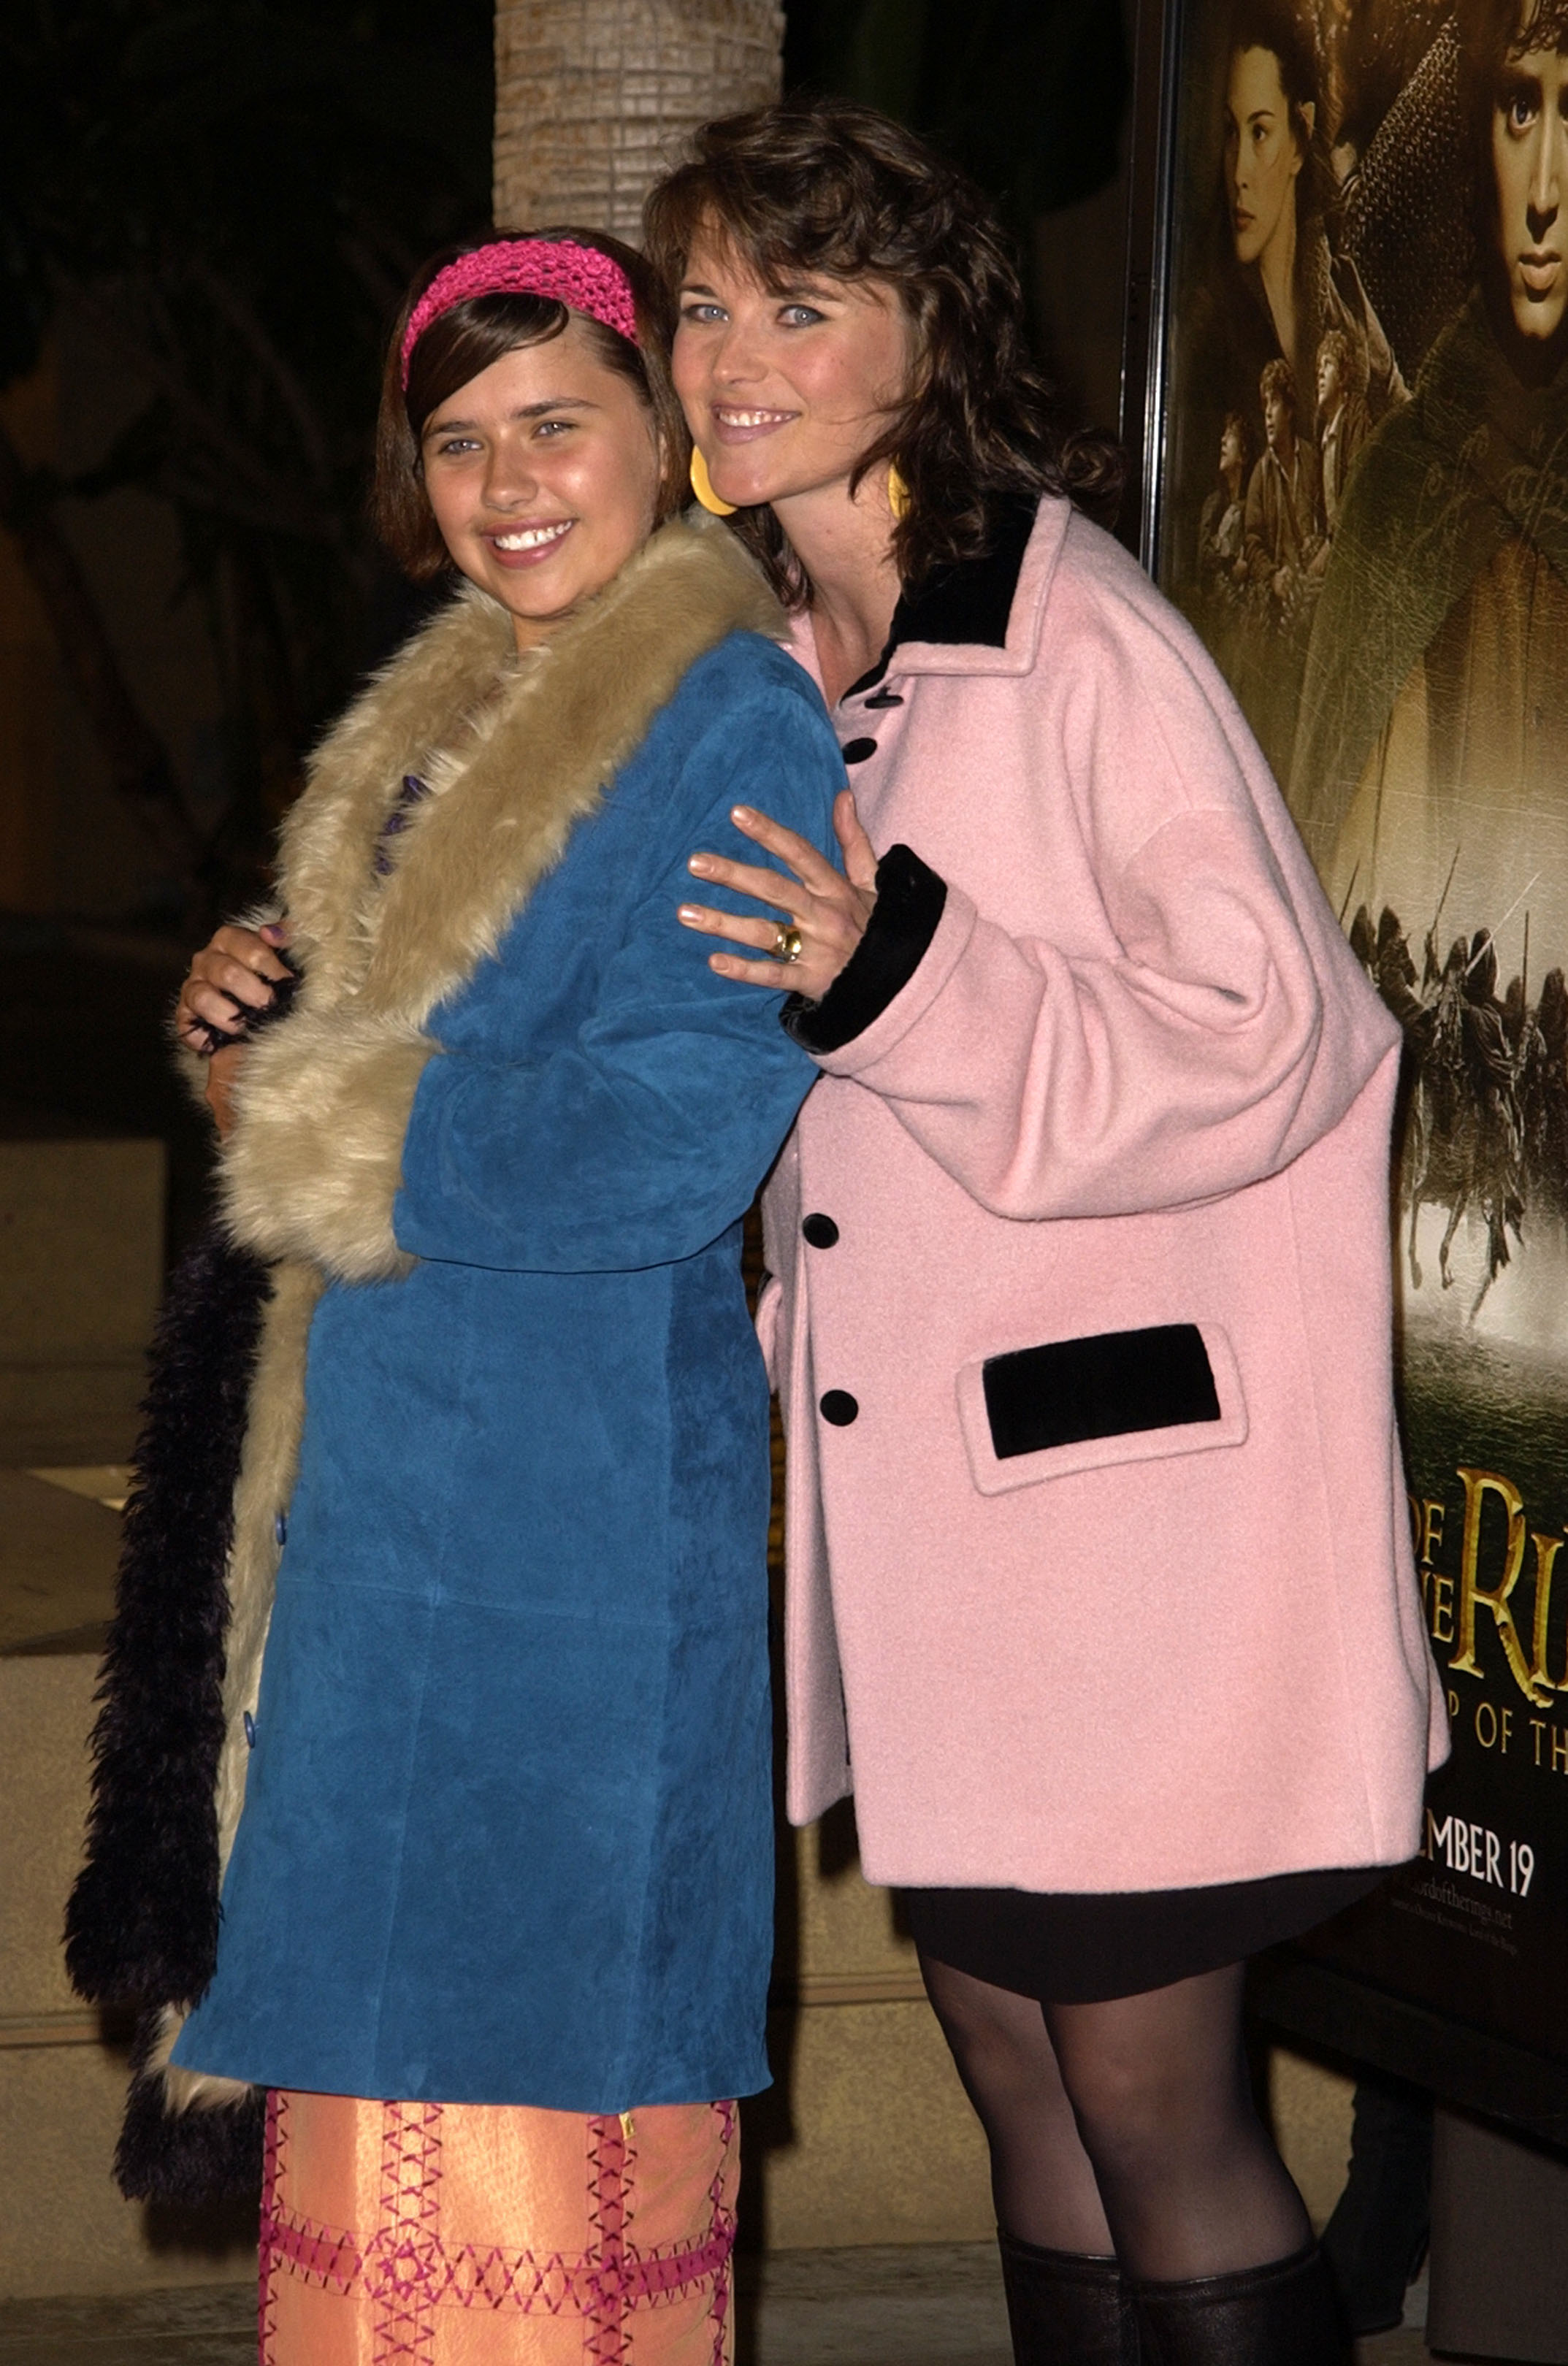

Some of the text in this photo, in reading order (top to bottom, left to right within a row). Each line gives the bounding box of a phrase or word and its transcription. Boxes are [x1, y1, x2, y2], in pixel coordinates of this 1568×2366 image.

[1475, 1702, 1512, 1753] OF
[1529, 1718, 1568, 1775] TH
[1420, 1807, 1534, 1898] MBER 19
